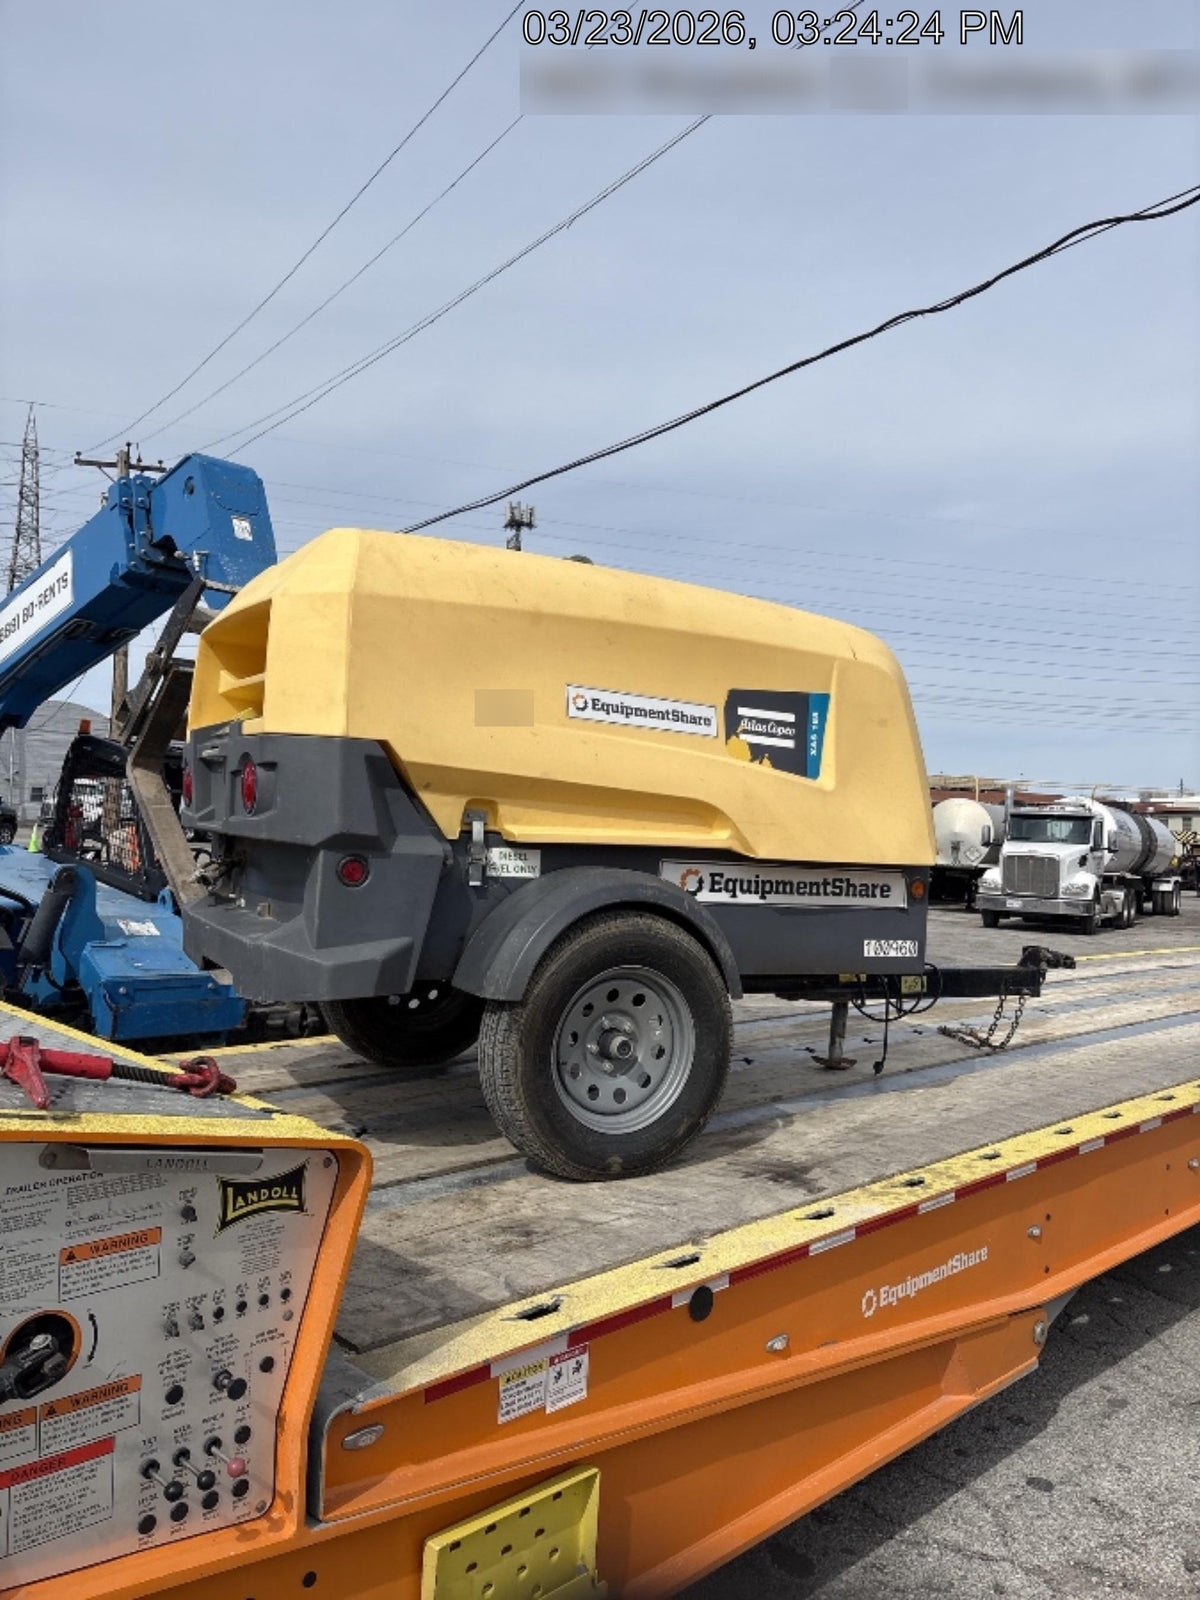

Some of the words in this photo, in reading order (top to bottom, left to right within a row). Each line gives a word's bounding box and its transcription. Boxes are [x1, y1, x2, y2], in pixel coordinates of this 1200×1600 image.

[591, 697, 711, 727] EquipmentShare
[708, 873, 892, 900] EquipmentShare
[226, 1186, 300, 1222] LANDOLL
[90, 1233, 149, 1254] WARNING
[880, 1246, 988, 1306] EquipmentShare
[71, 1384, 129, 1407] WARNING
[11, 1457, 66, 1482] DANGER
